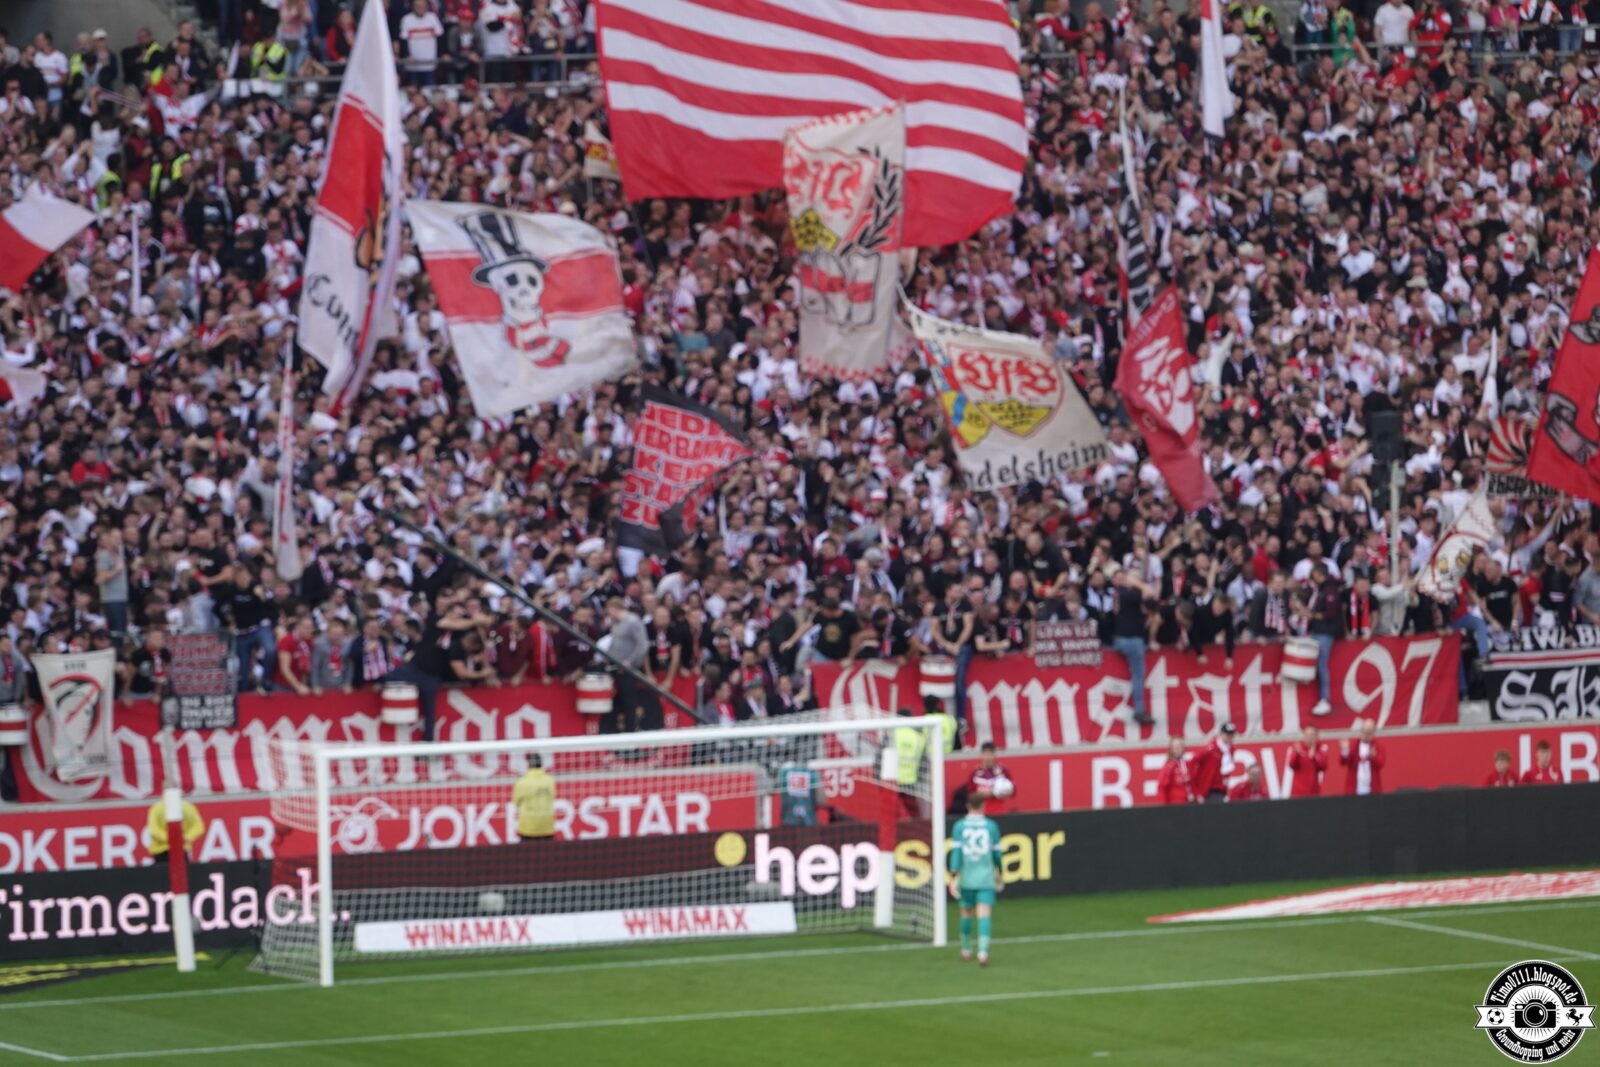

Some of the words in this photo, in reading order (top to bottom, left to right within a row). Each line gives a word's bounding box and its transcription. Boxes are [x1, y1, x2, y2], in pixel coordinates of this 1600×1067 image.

[827, 649, 1306, 757] Cnnstatt
[1342, 638, 1444, 729] 97
[824, 769, 855, 798] 35
[961, 828, 990, 856] 33
[0, 866, 351, 941] irmendach.
[404, 918, 532, 948] WINAMAX
[622, 907, 749, 937] WINAMAX
